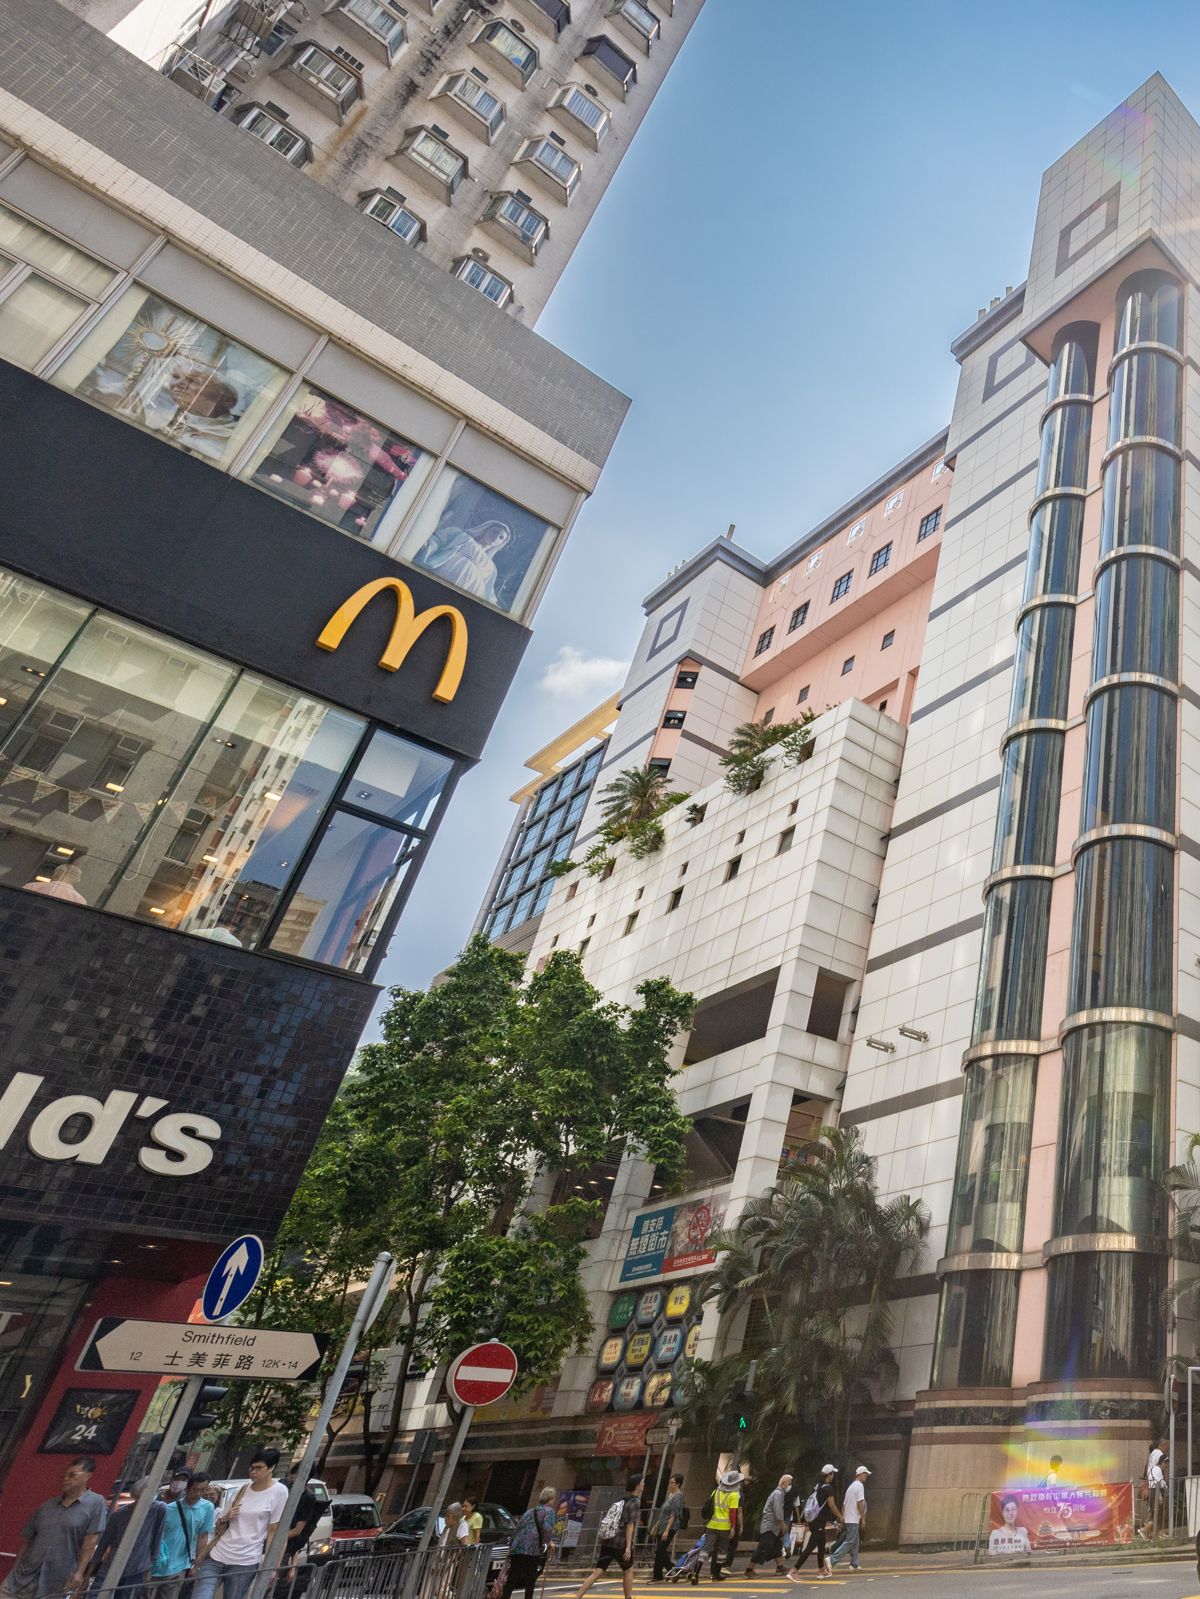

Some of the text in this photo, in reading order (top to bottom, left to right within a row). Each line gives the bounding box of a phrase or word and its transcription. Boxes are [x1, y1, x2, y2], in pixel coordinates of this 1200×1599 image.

[181, 1330, 257, 1347] Smithfield
[128, 1351, 143, 1361] 12
[163, 1351, 254, 1370] 士美菲路
[70, 1424, 98, 1440] 24
